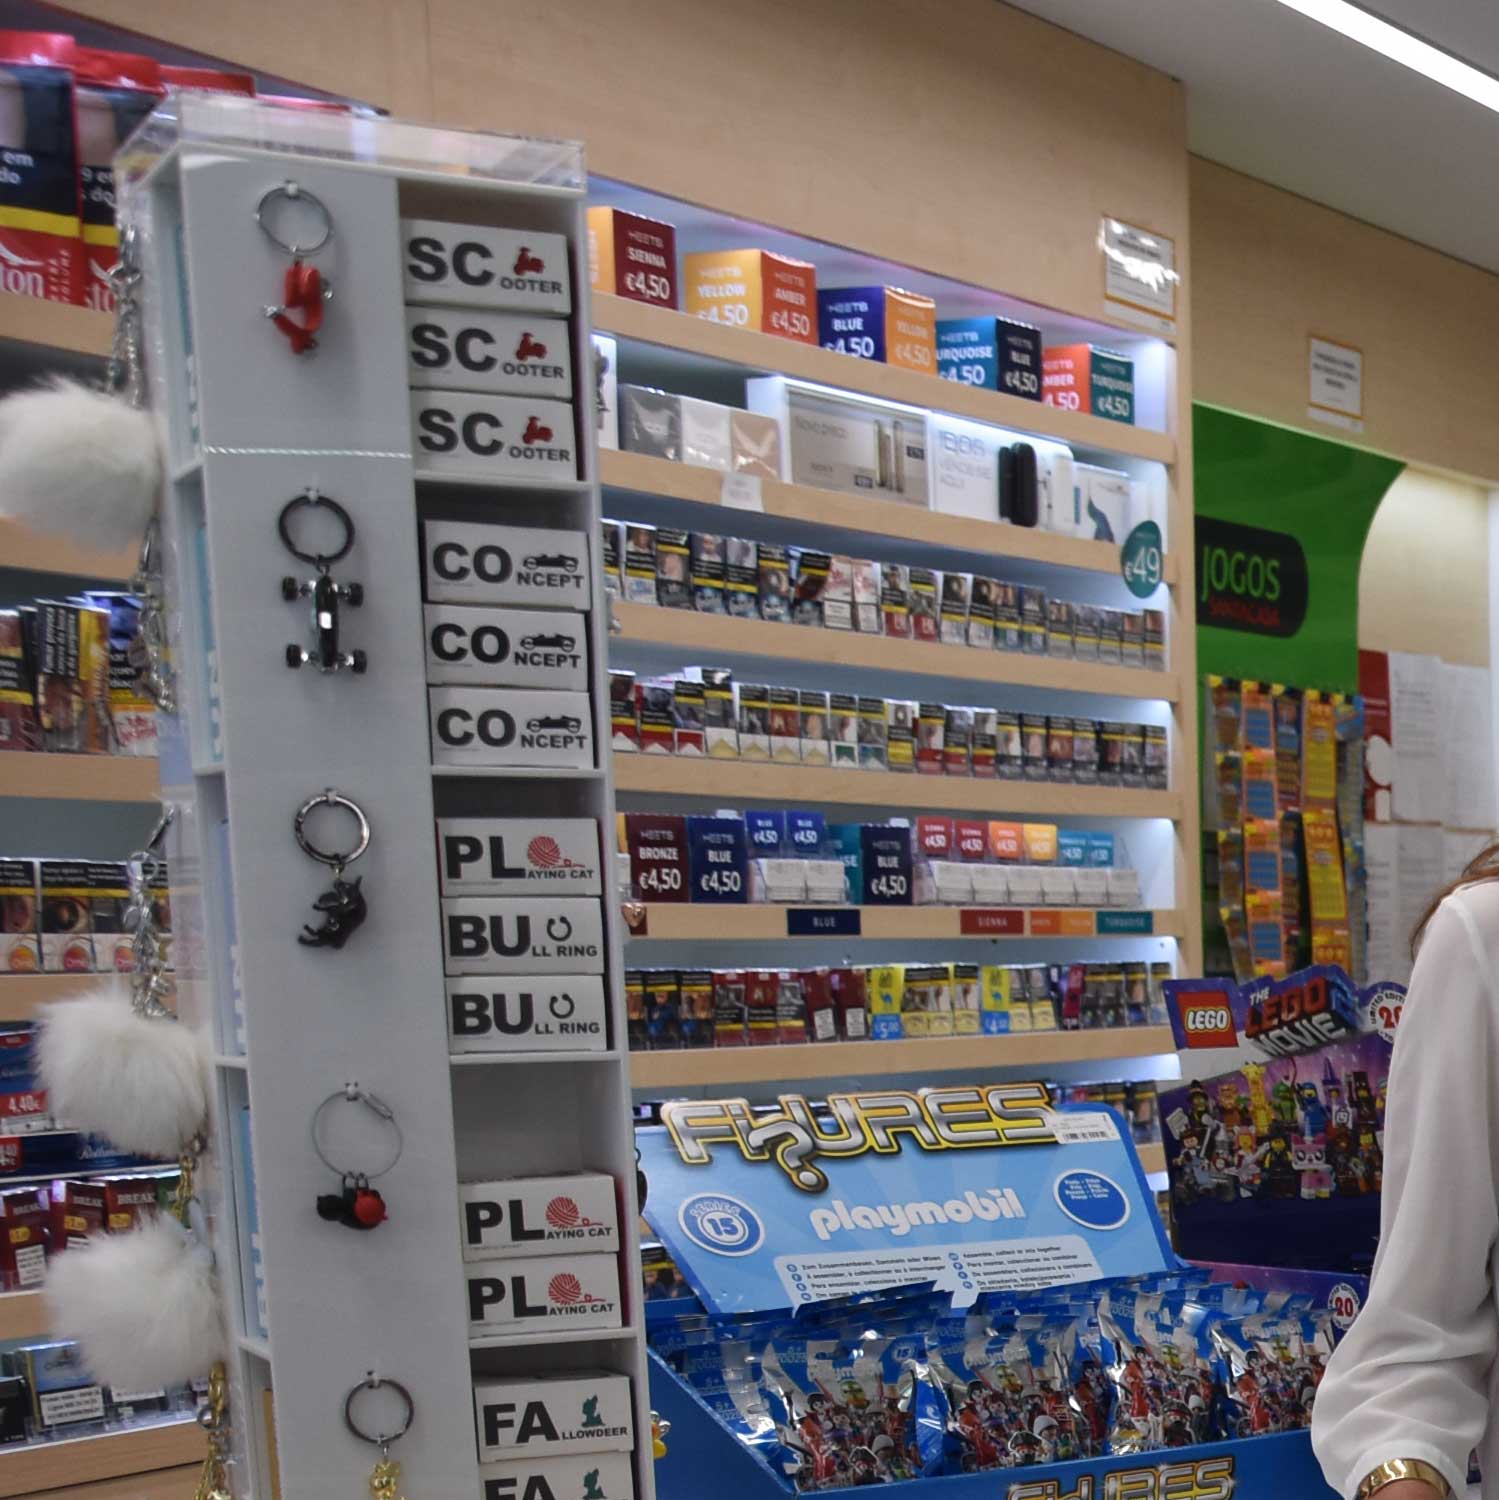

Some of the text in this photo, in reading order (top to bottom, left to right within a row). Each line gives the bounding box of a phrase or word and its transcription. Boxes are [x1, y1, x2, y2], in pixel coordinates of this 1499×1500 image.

[407, 236, 563, 295] SC OOTER
[626, 248, 667, 269] SIENNA
[697, 284, 747, 298] YELLOW
[832, 319, 864, 331] BLUE
[410, 323, 565, 379] SC OOTER
[1010, 350, 1031, 366] BLUE
[1042, 375, 1075, 385] MBER
[417, 407, 571, 462] SC OOTER
[432, 541, 584, 588] CO NCEPT
[1123, 549, 1160, 585] €49
[1201, 545, 1281, 601] JOGOS
[430, 623, 582, 668] CO NCEPT
[436, 707, 588, 749] CO NCEPT
[444, 835, 595, 879] PL AYING CAT
[639, 847, 679, 862] BRONZE
[707, 849, 733, 864] BLUE
[876, 855, 899, 868] BLUE
[638, 867, 682, 891] €4,50
[700, 871, 742, 894] €4,50
[870, 874, 908, 898] €4,50
[812, 917, 837, 927] BLUE
[447, 915, 598, 957] BU LL RING
[1245, 976, 1329, 1038] LEGO
[1250, 986, 1271, 1006] THE
[451, 993, 601, 1036] BU LL RING
[1187, 1009, 1228, 1031] LEGO
[117, 1192, 156, 1204] BREAK
[465, 1199, 613, 1245] PL AYING CAT
[809, 1187, 1027, 1241] playmobil
[707, 1217, 739, 1236] 15
[467, 1276, 615, 1322] PL AYING CAT
[1334, 1297, 1354, 1318] 20
[482, 1401, 629, 1447] FA LLOWDEER
